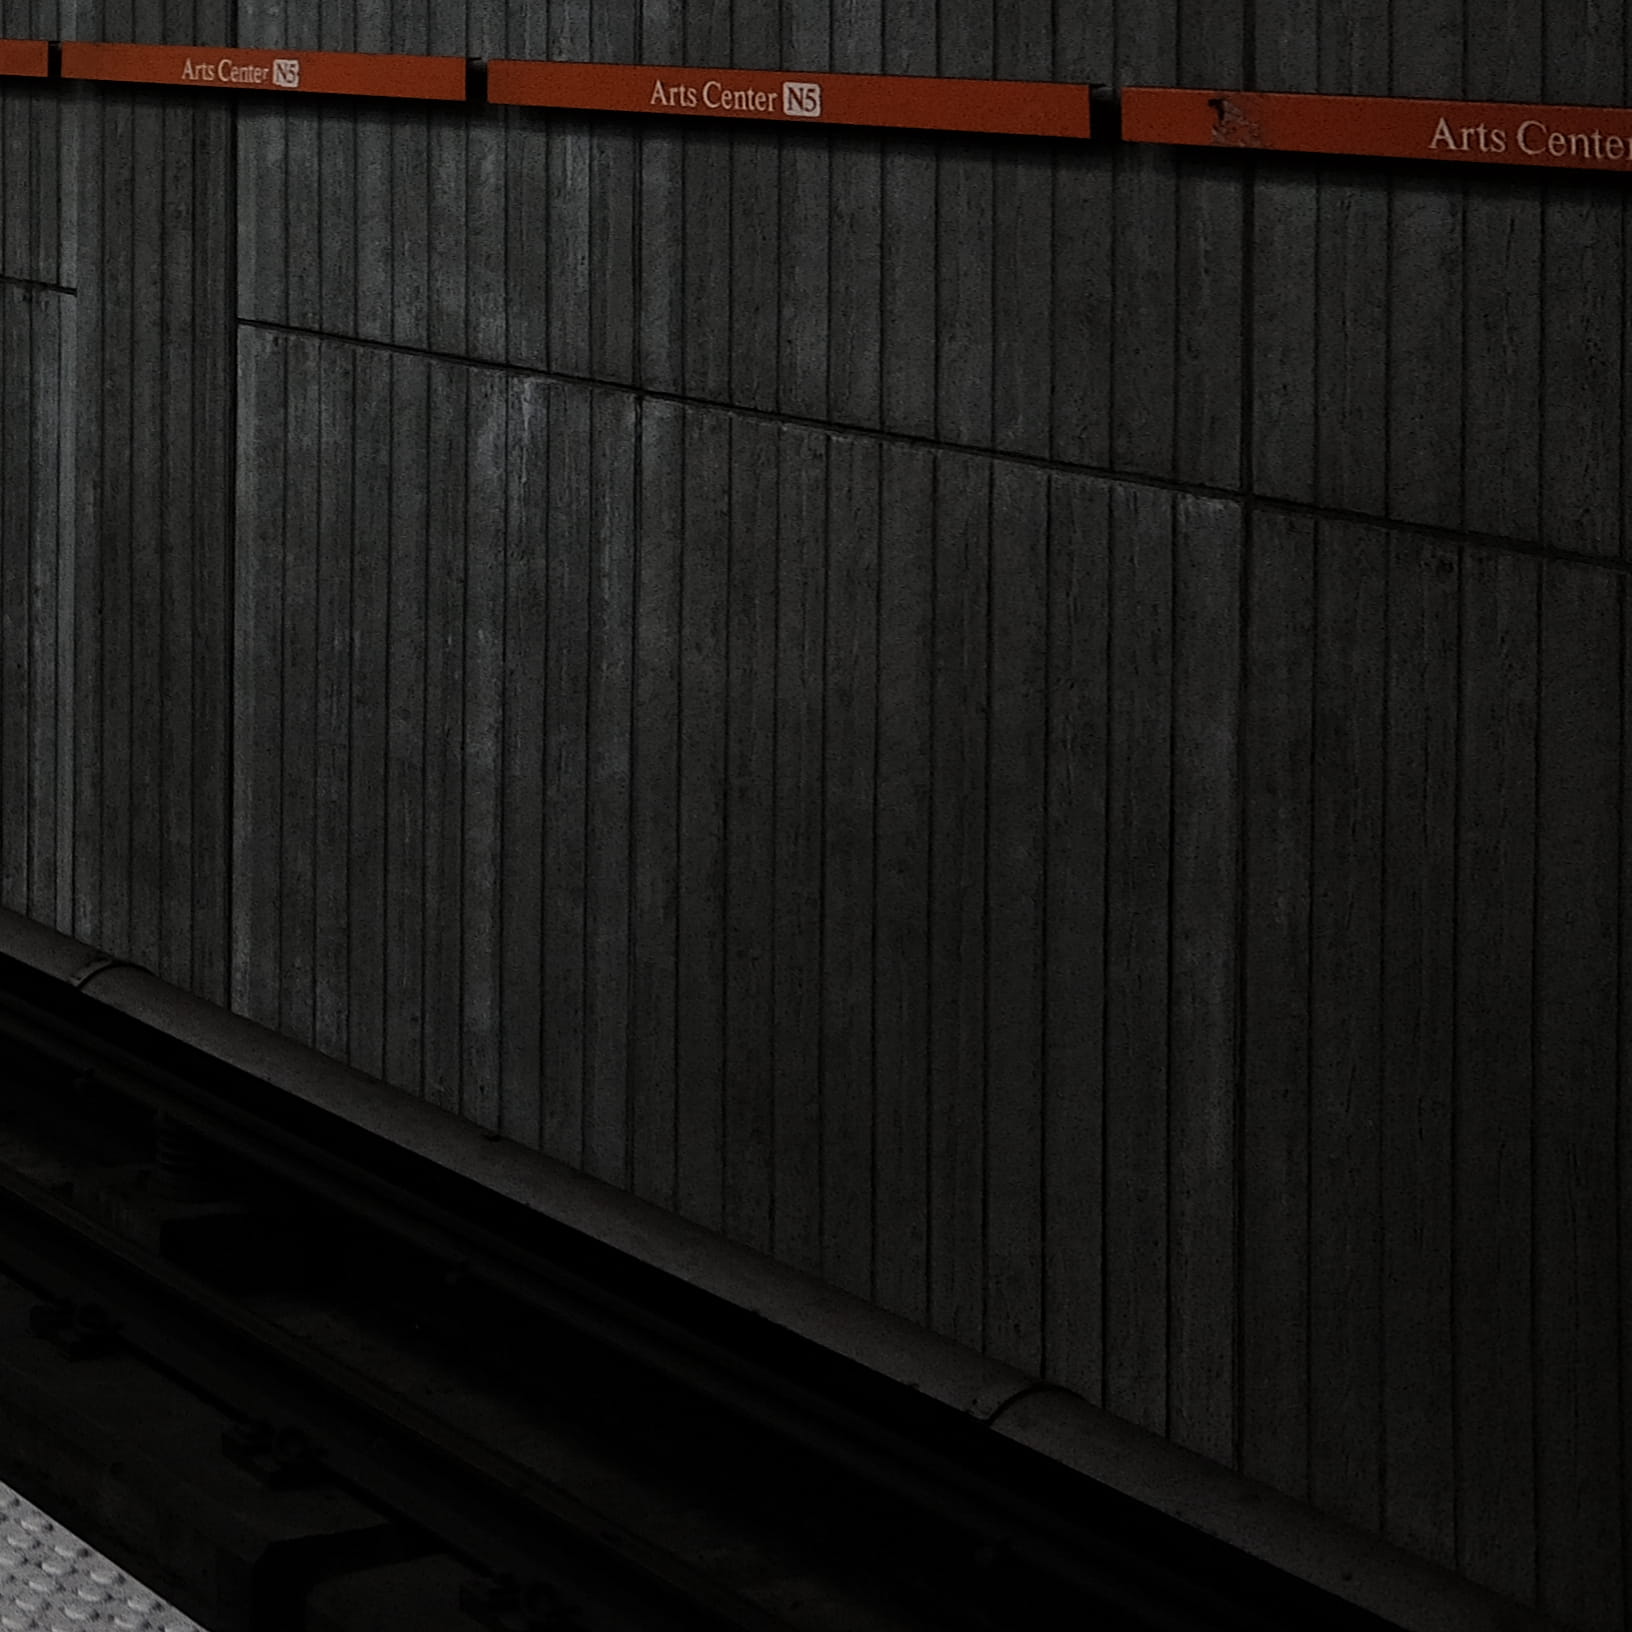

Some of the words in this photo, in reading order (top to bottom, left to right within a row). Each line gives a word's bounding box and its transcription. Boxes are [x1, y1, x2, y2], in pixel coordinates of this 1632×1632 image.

[181, 57, 215, 80] Arts
[217, 58, 269, 83] Center
[275, 61, 298, 85] N5
[650, 79, 697, 107] Arts
[702, 80, 778, 111] Center
[785, 85, 819, 113] N5
[1428, 117, 1506, 152] Arts
